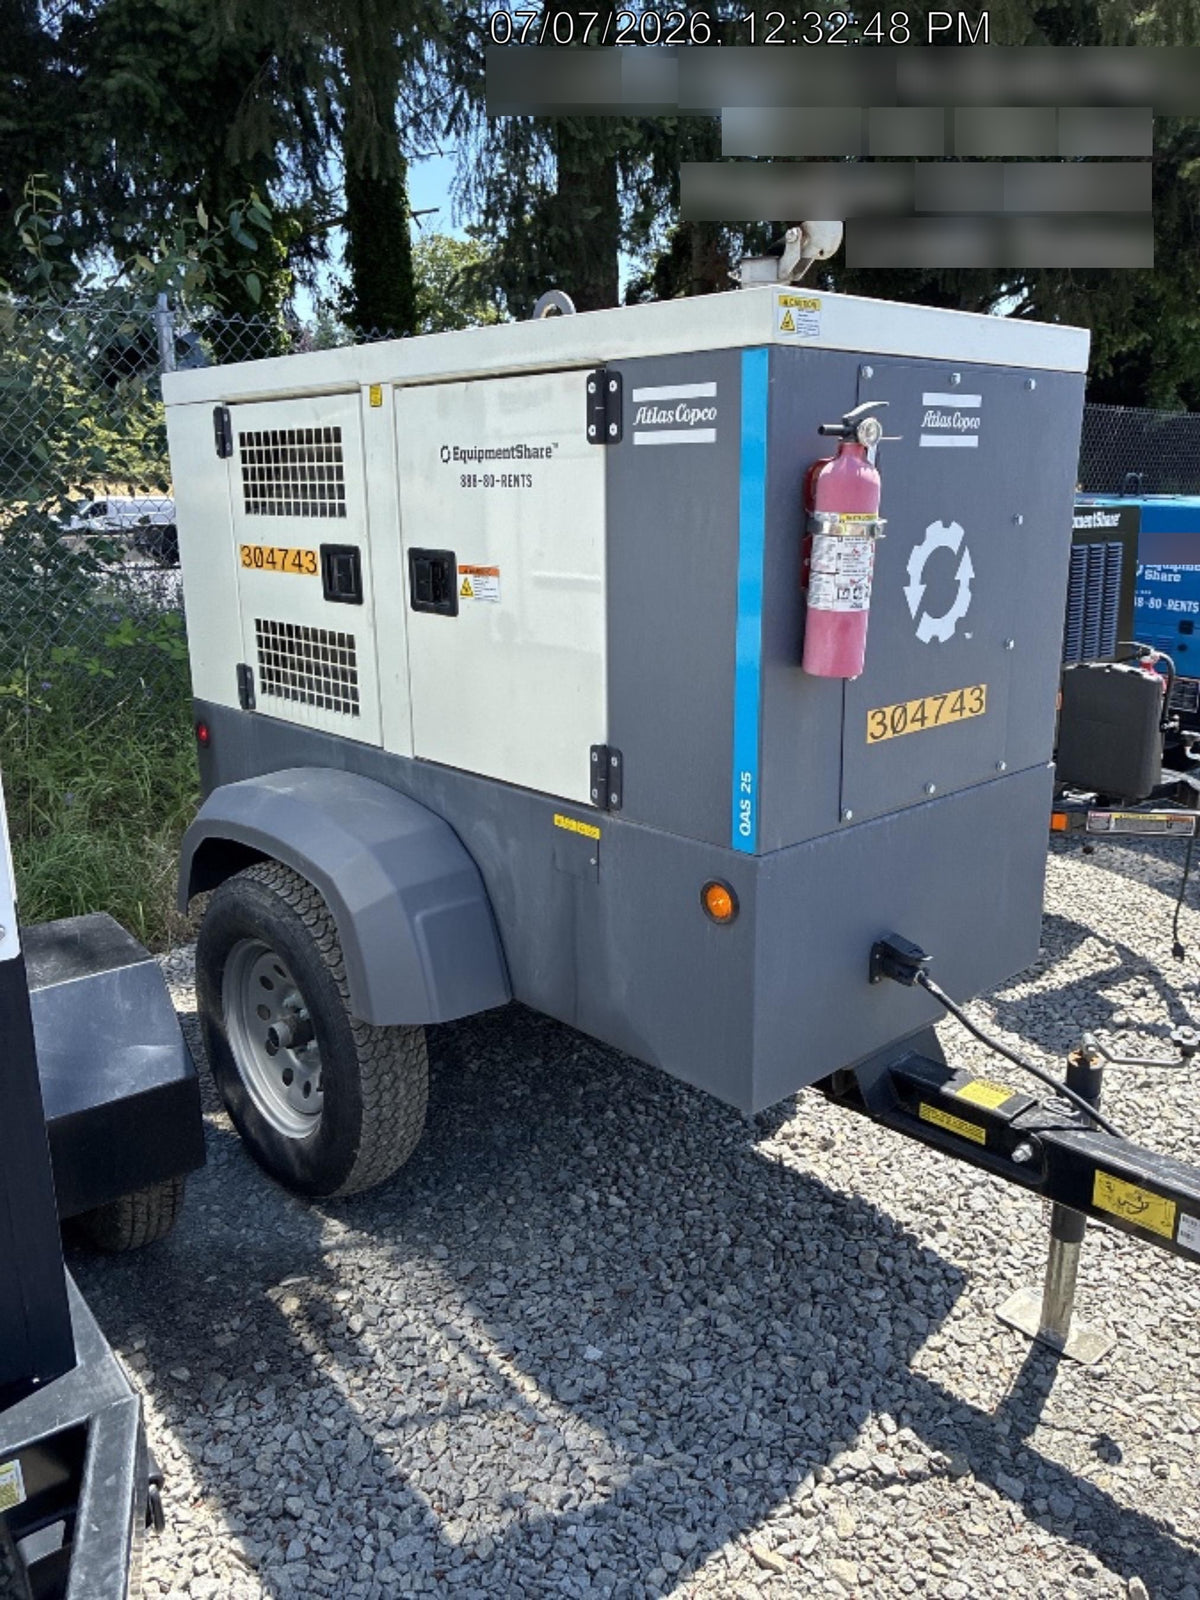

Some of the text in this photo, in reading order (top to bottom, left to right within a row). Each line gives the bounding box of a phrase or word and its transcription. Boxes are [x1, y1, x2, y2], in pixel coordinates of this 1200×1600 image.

[632, 403, 717, 426] Atlas Copco
[921, 410, 981, 432] Atlas Copco
[460, 474, 533, 488] 888-80-RENTS
[241, 545, 318, 573] 304743
[1144, 569, 1182, 582] Share
[869, 686, 985, 740] 304743
[739, 770, 752, 837] QAS 25
